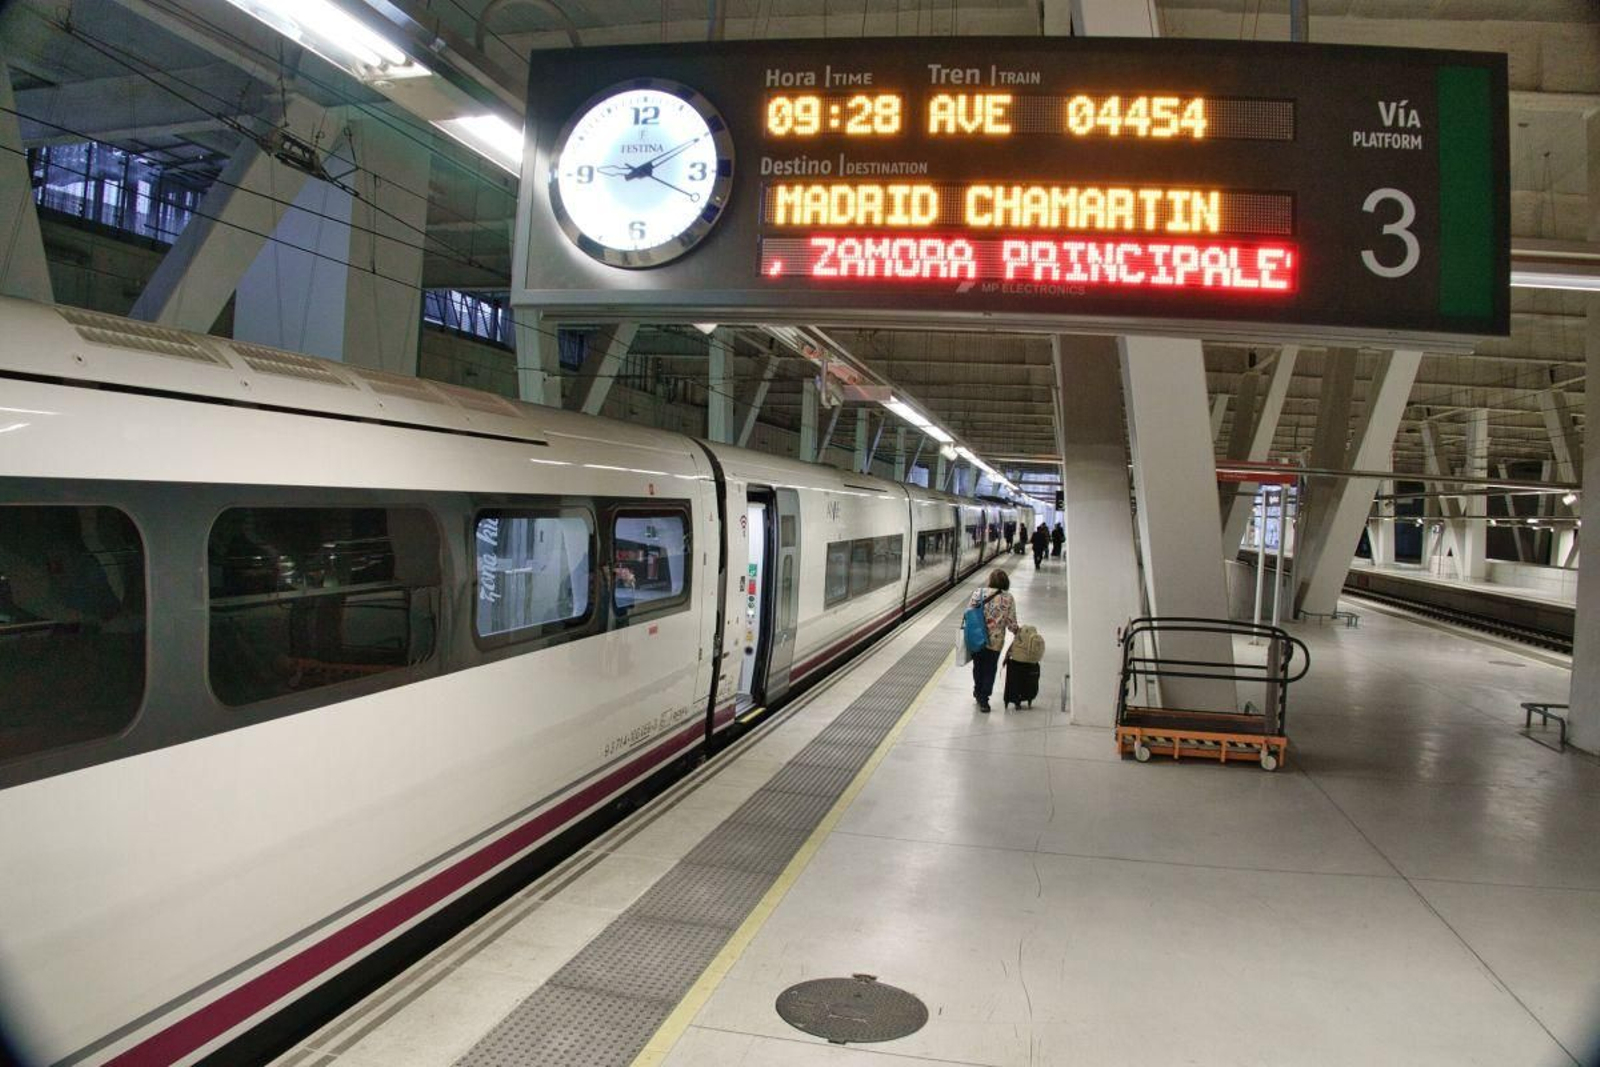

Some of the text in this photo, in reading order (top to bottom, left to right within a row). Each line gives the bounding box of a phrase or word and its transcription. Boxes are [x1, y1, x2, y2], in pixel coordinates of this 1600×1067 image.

[765, 69, 873, 87] Hora TIME
[928, 64, 1041, 85] Tren TRAIN
[630, 106, 660, 126] 12
[767, 95, 901, 135] 09:28
[928, 94, 1208, 138] AVE 04454
[620, 143, 664, 154] FESTINA
[1353, 131, 1422, 150] PLATFORM
[576, 165, 595, 184] 9
[688, 162, 707, 181] 3
[760, 156, 928, 176] Destino DESTINATION
[775, 184, 1220, 233] MADRID CHAMARTIN
[628, 221, 646, 240] 6
[1361, 188, 1421, 278] 3
[811, 238, 977, 278] ZAMORA
[1002, 284, 1086, 296] ELECTRONICS
